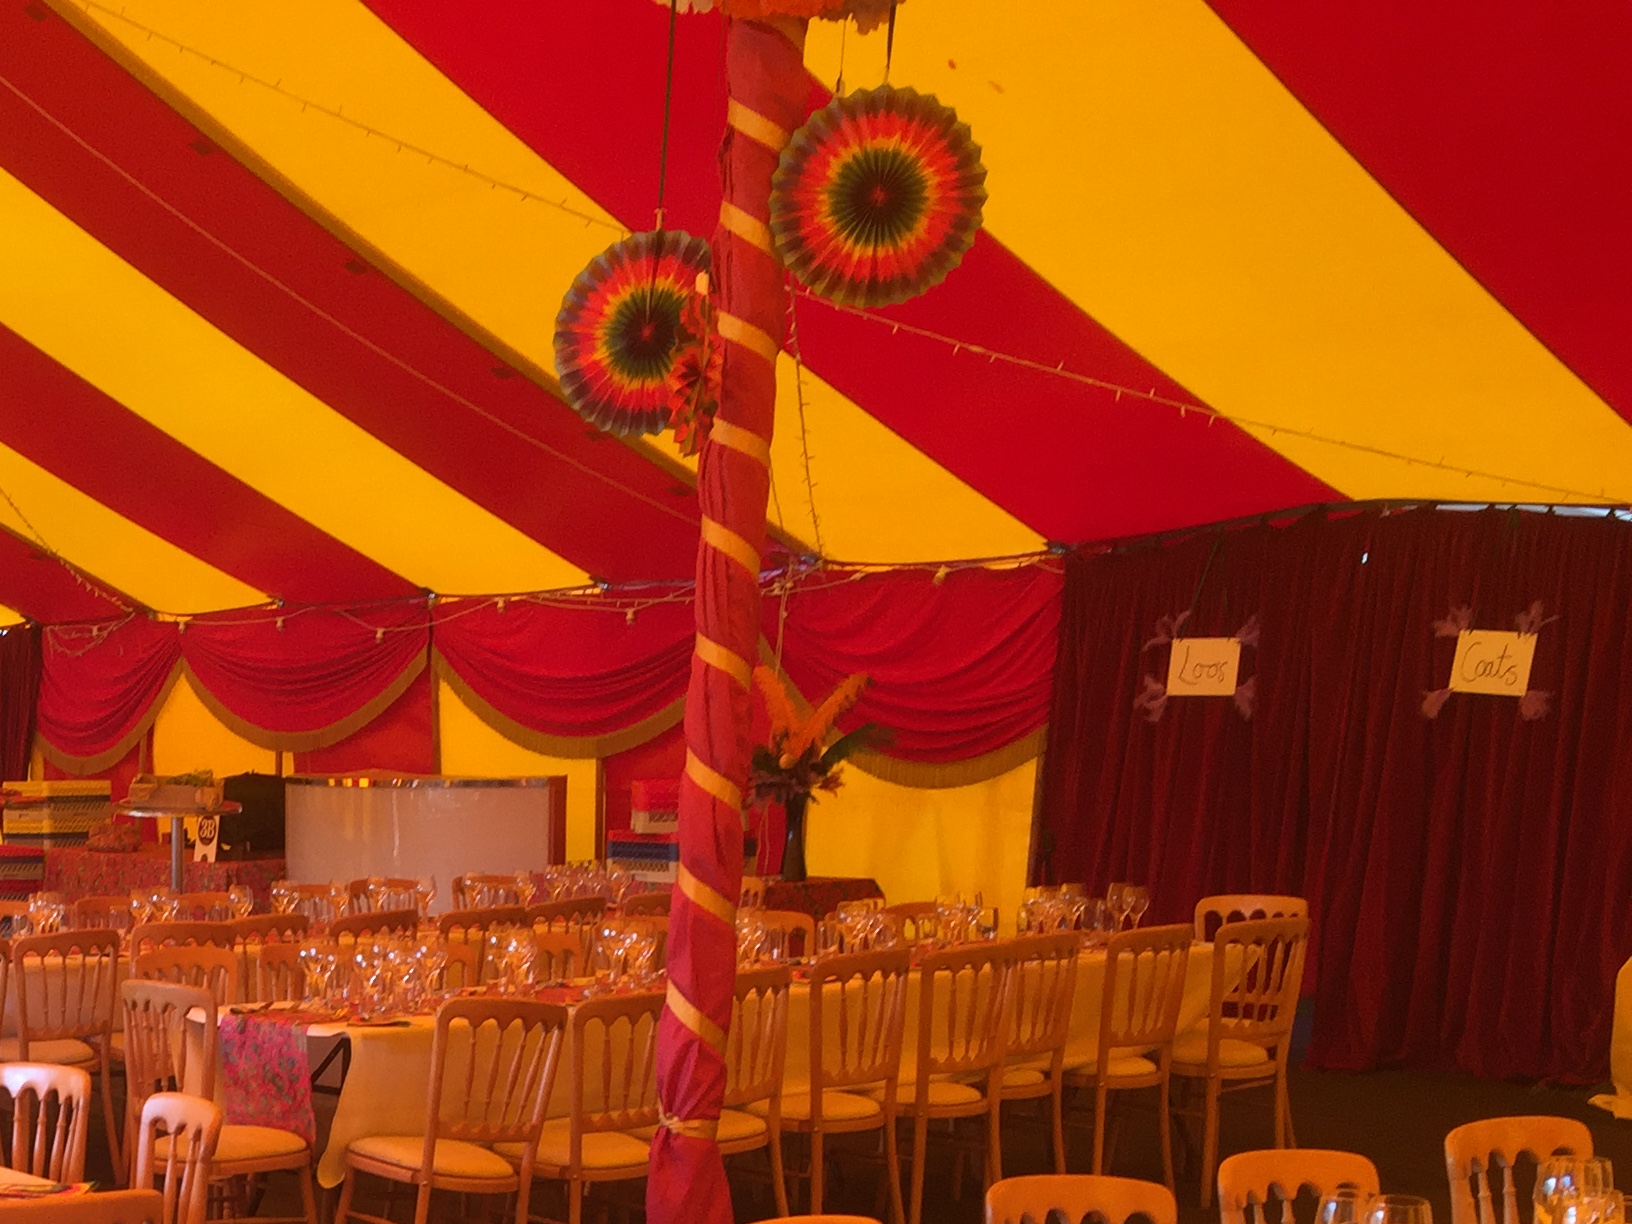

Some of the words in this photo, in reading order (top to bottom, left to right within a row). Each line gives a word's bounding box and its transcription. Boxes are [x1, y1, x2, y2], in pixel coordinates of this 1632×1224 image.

[1178, 644, 1228, 686] Loos
[1460, 641, 1518, 686] Coats
[199, 818, 216, 839] 3B
